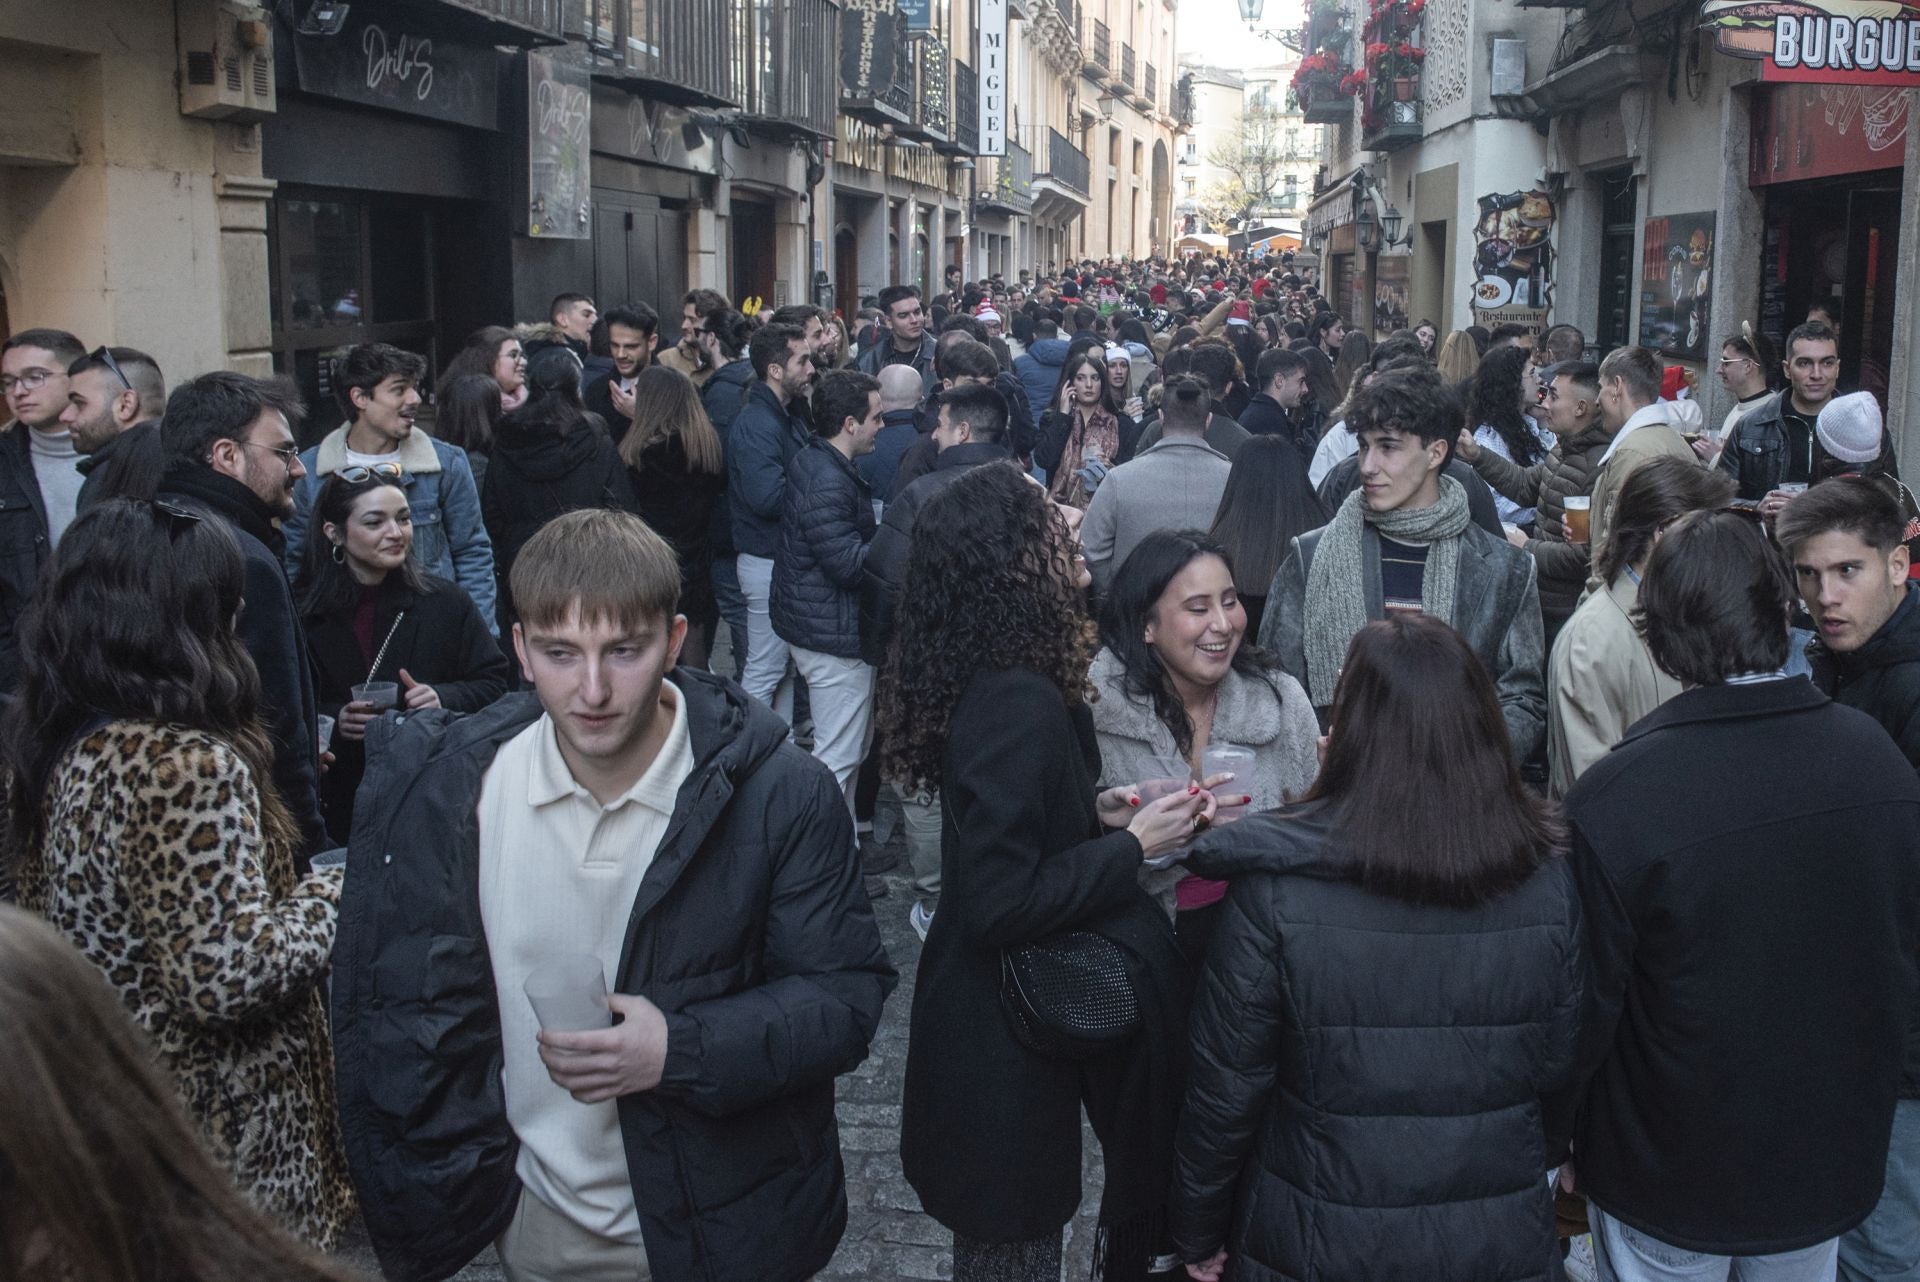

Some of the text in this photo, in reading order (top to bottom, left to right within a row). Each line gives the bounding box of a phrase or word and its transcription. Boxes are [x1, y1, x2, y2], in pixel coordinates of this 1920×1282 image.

[986, 33, 1000, 152] MIGUEL
[844, 115, 882, 173] HOTEL
[895, 146, 949, 192] RESTAURANTE
[1480, 310, 1541, 322] Restaurante
